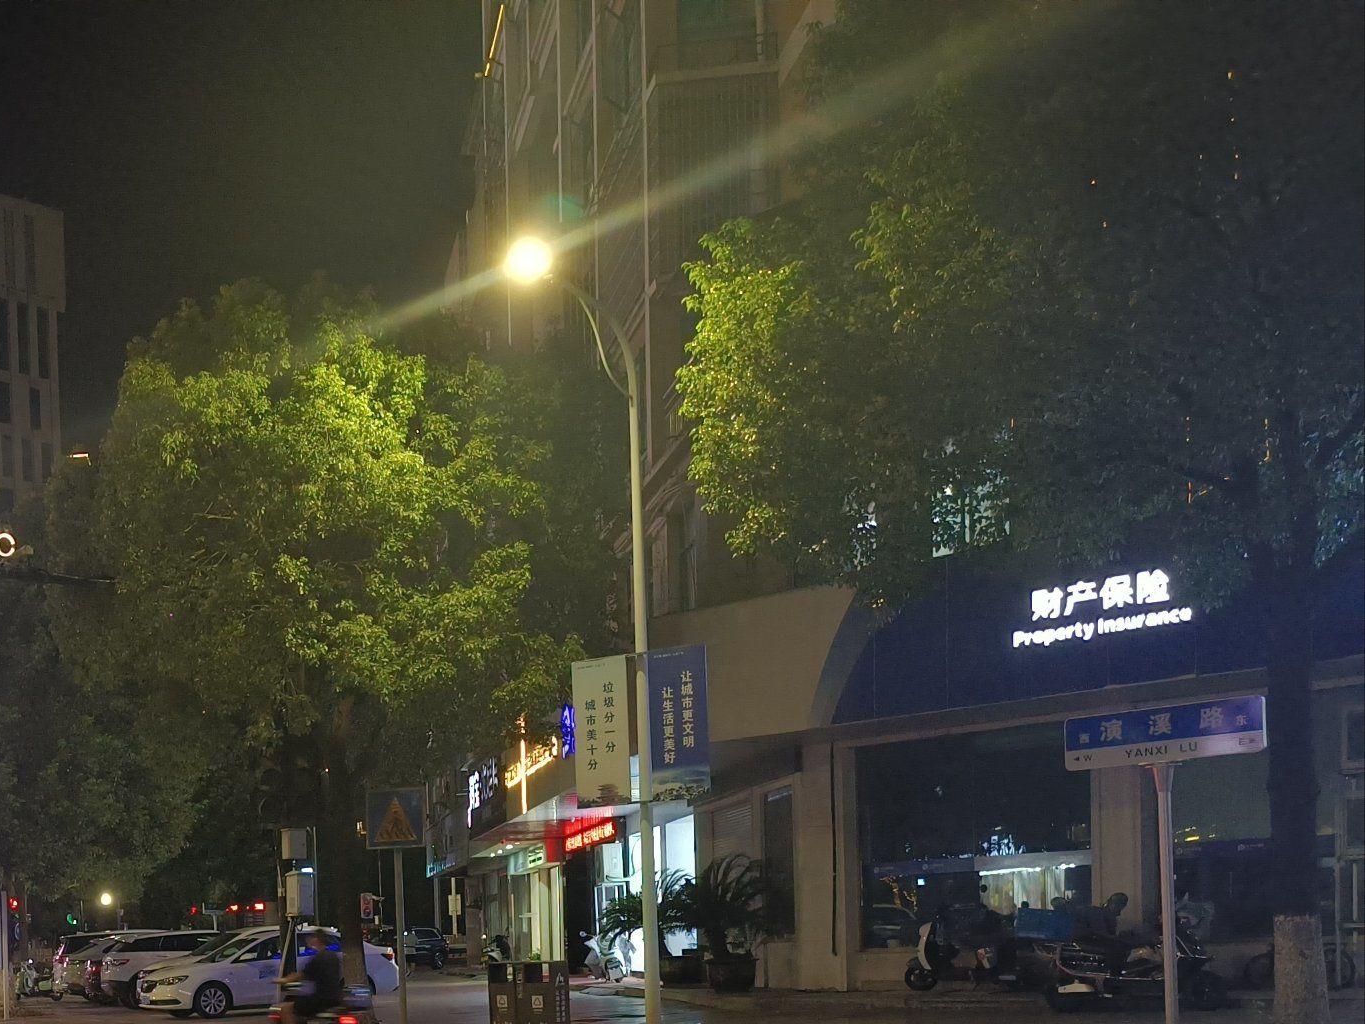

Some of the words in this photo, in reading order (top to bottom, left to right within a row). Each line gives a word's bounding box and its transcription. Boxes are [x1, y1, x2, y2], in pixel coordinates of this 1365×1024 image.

[1012, 621, 1094, 648] Property
[1097, 607, 1192, 634] Insurance
[1031, 568, 1170, 622] 财产保险
[585, 699, 598, 771] 城市美十分
[603, 681, 616, 753] 垃圾分一分
[661, 686, 676, 764] 让生活更美好
[680, 670, 694, 748] 让城市更文明
[1125, 746, 1168, 759] YANXI
[1179, 742, 1198, 753] LU
